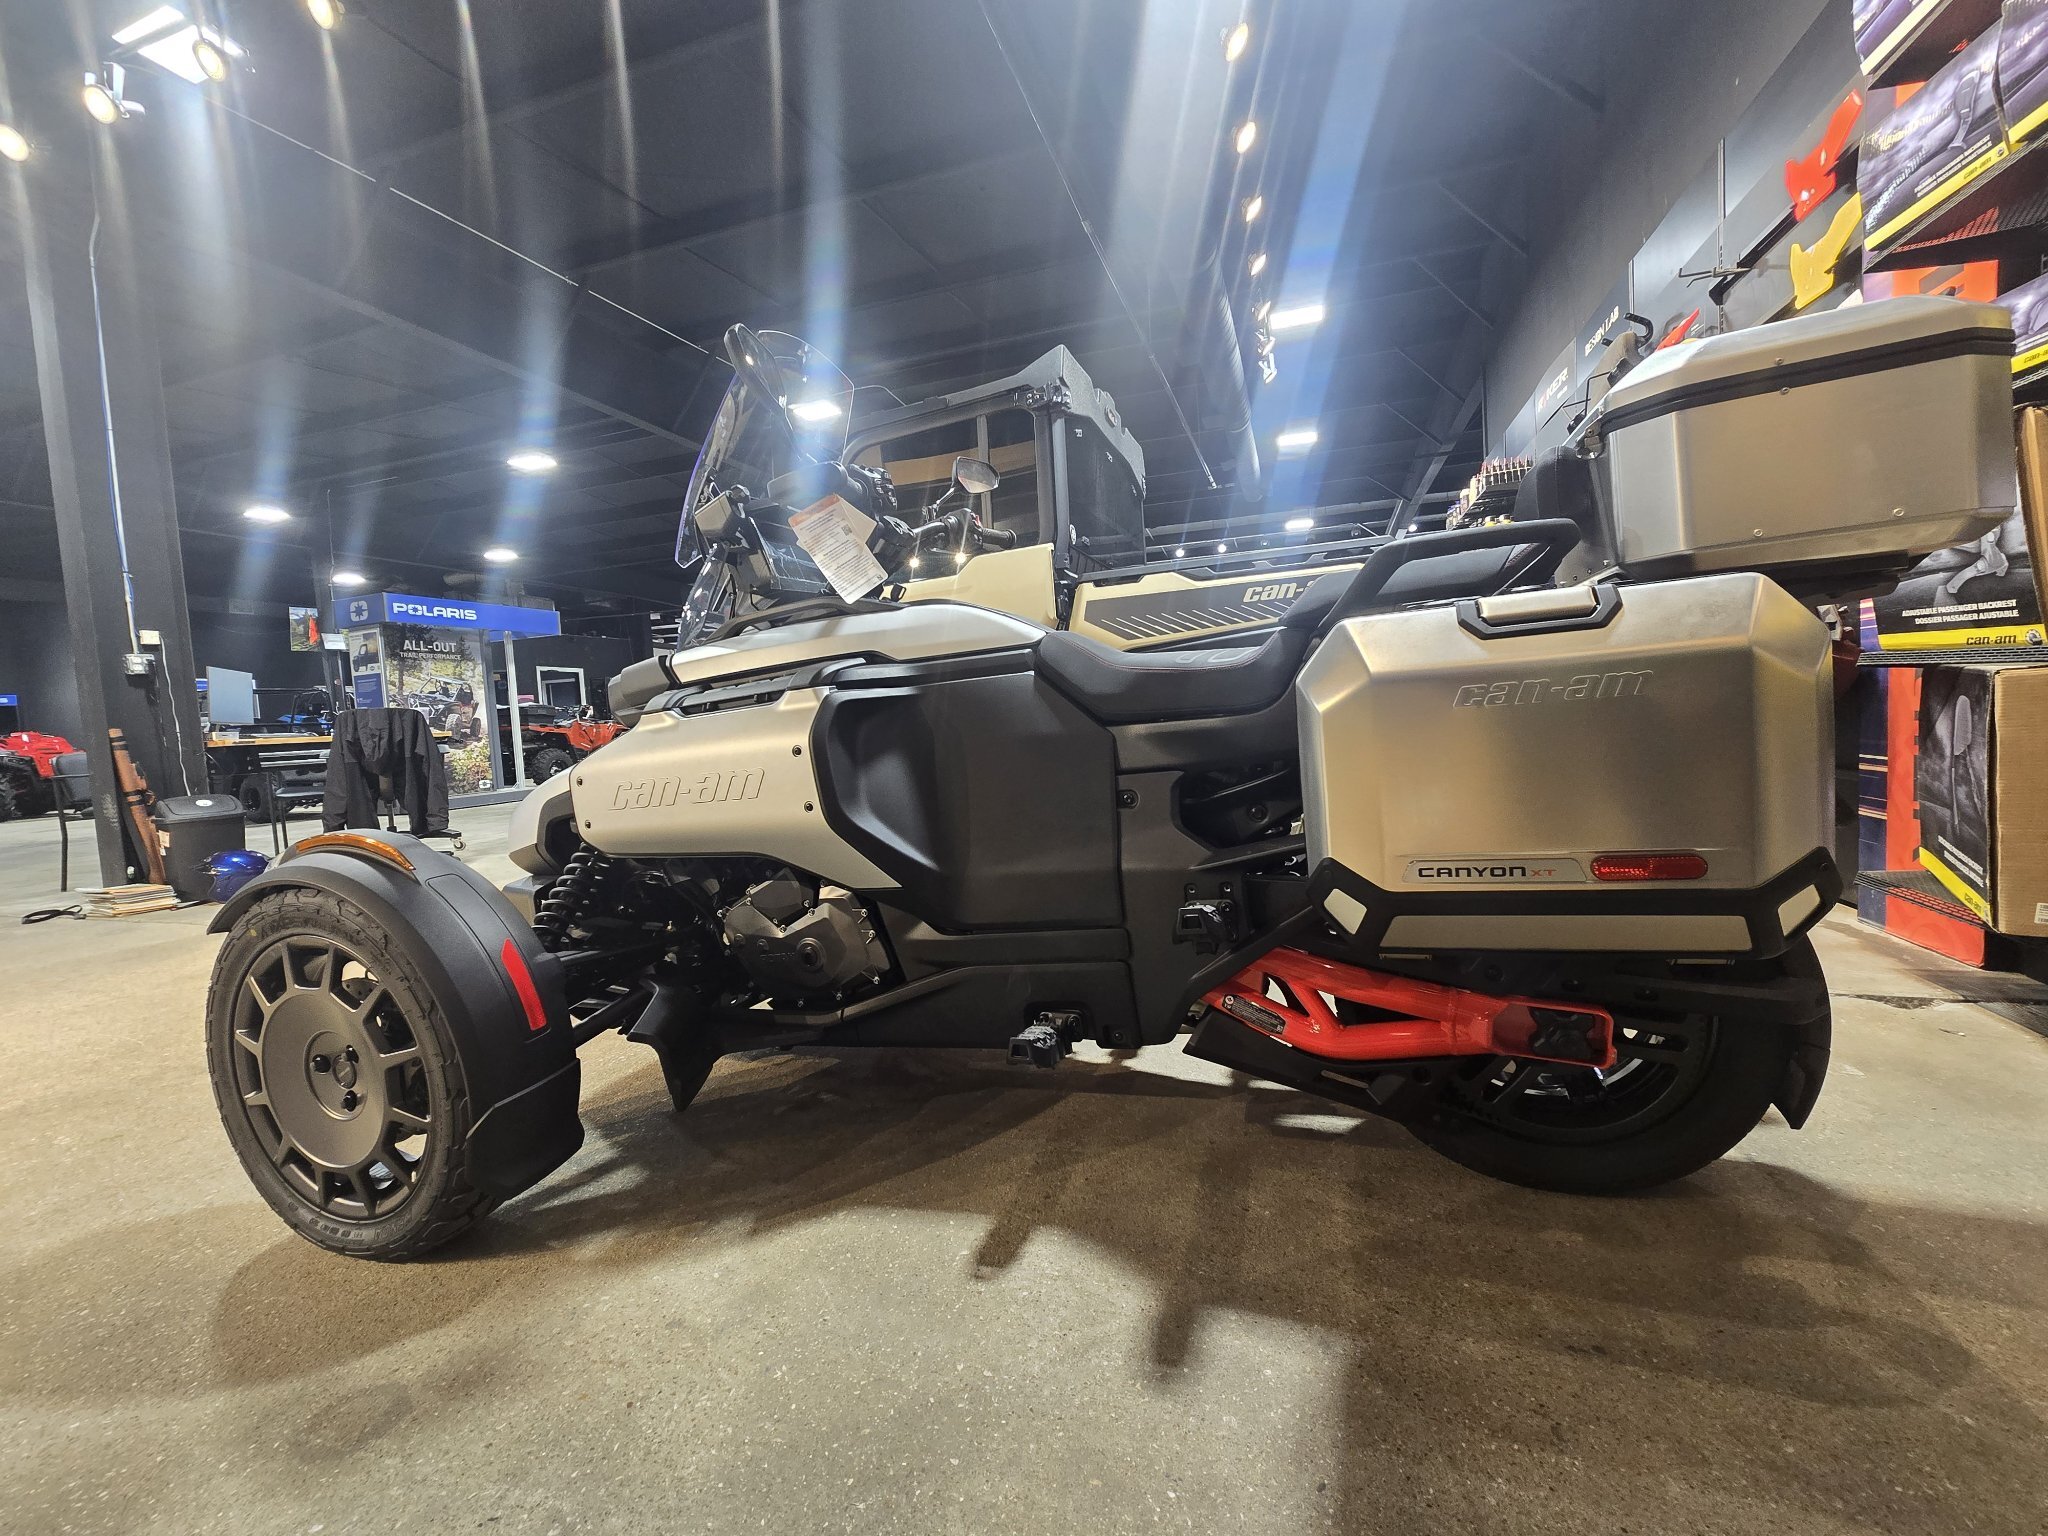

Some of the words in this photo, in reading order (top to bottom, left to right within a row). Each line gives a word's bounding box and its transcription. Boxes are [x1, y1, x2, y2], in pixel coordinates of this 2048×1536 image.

[1604, 305, 1619, 334] LAB
[392, 602, 477, 621] POLARIS
[1902, 606, 1938, 617] ADJUSTABLE
[1938, 602, 1978, 614] PASSENGER
[1978, 599, 2017, 610] BACKREST
[1915, 616, 1942, 625] DOSSIER
[1943, 612, 1979, 623] PASSAGER
[1979, 609, 2019, 620] AJUSTABLE
[403, 639, 457, 653] ALL-OUT
[419, 652, 462, 661] PERFORMANCE
[1453, 669, 1654, 708] can-am
[608, 767, 766, 812] can-am
[1417, 865, 1527, 878] CANYON
[1530, 869, 1558, 877] XT
